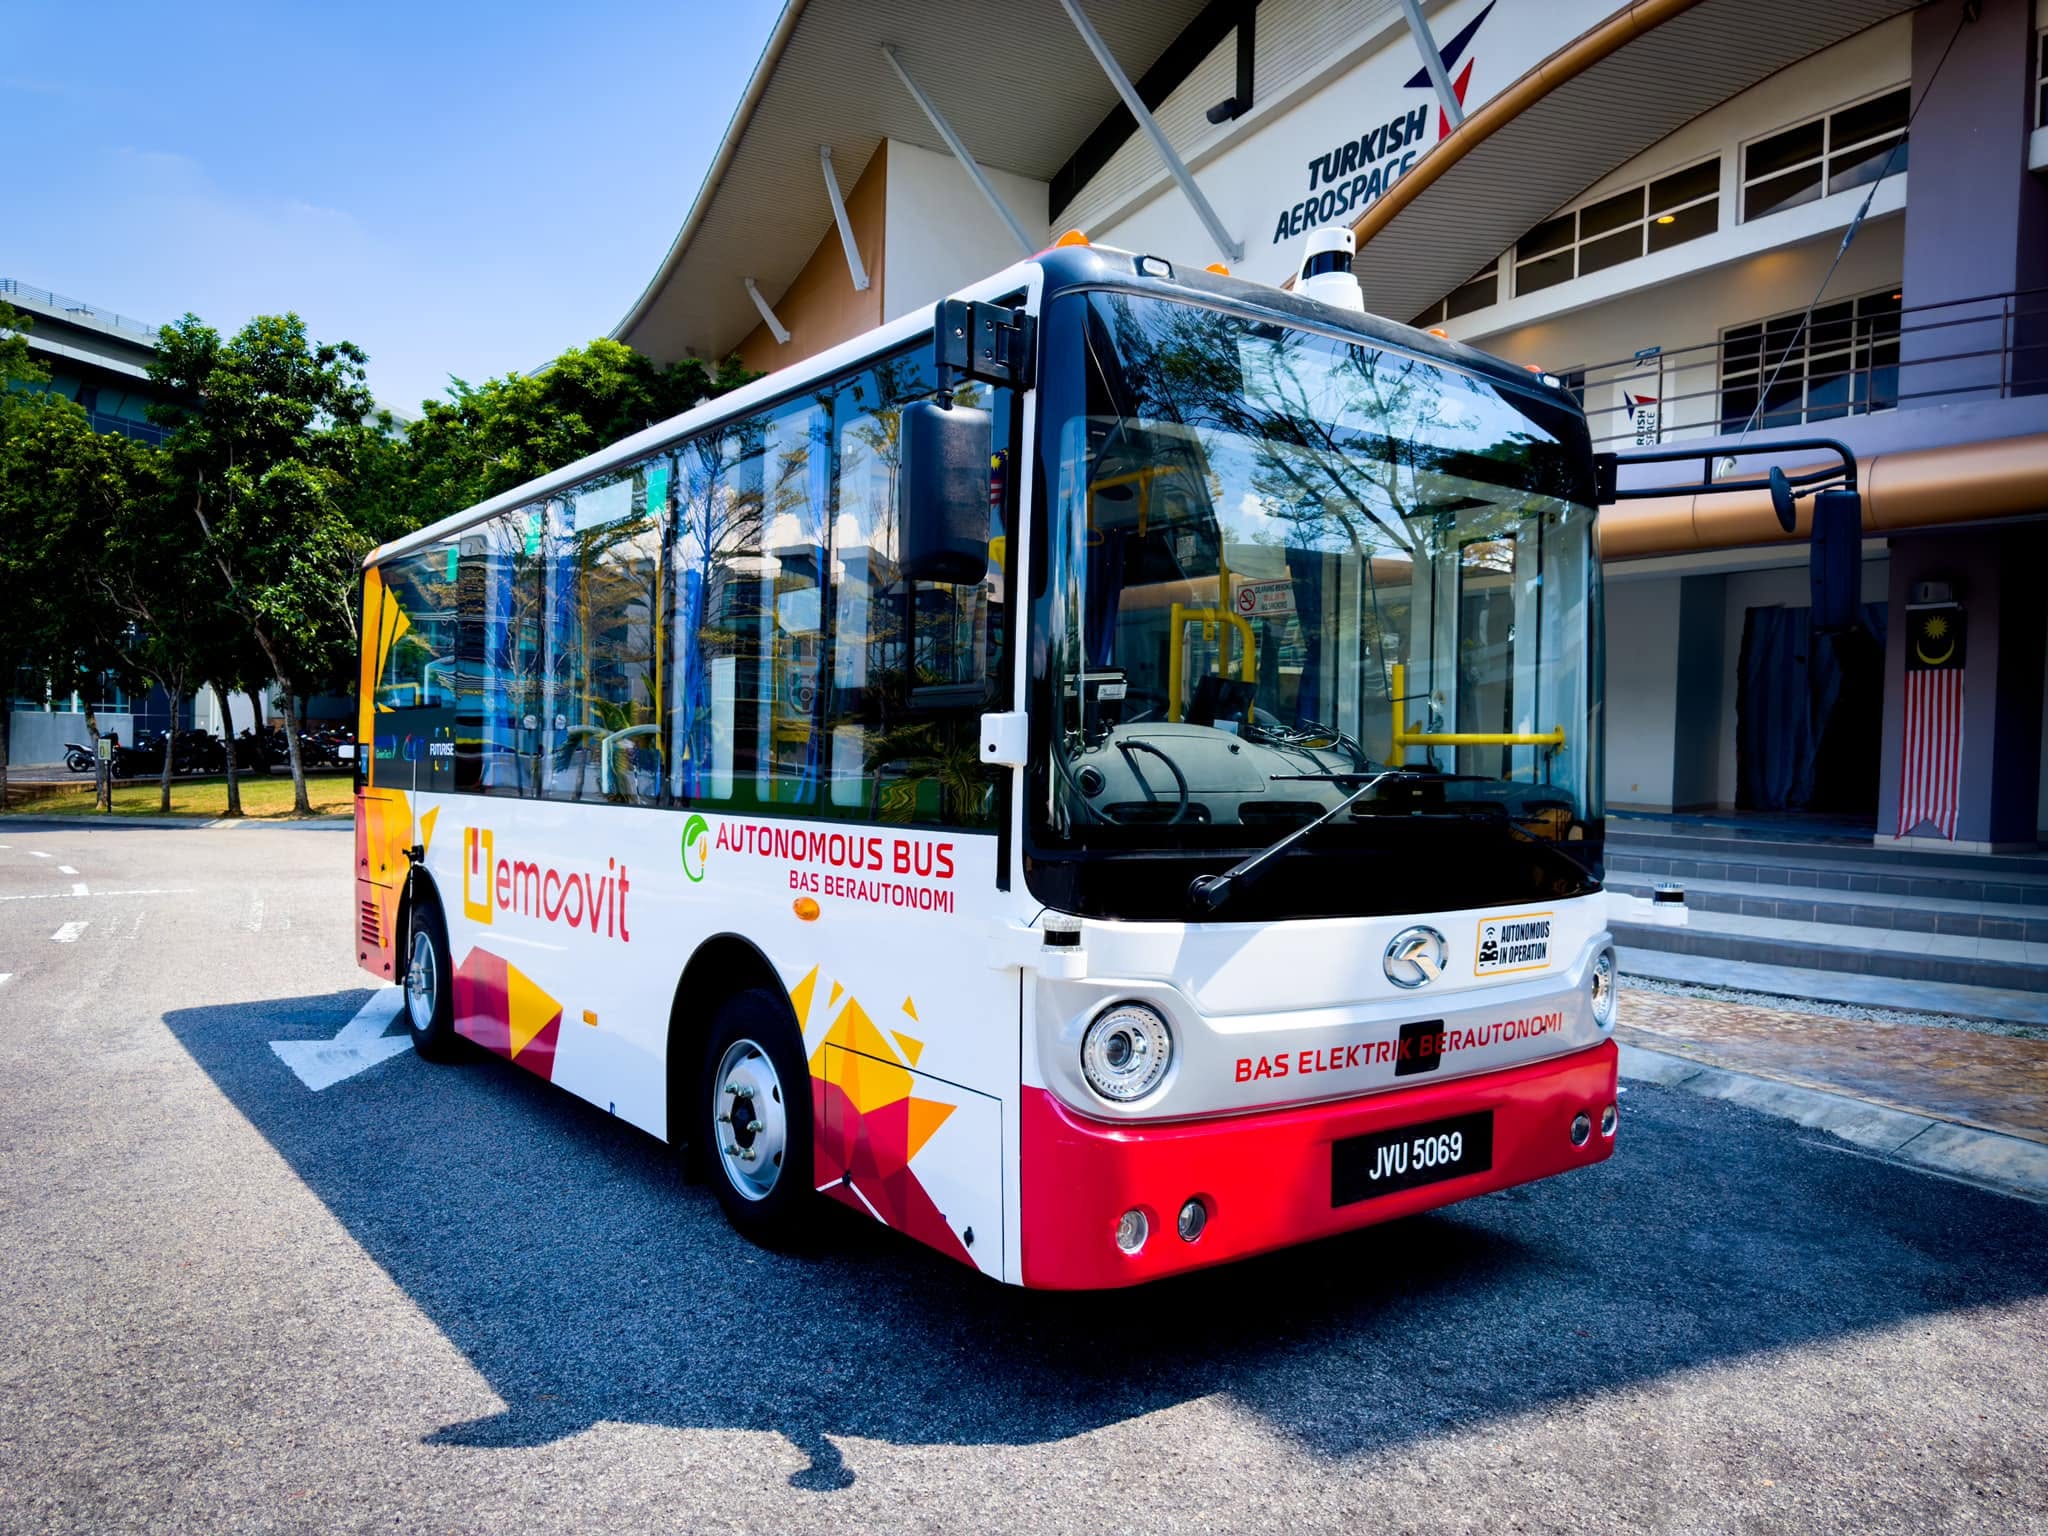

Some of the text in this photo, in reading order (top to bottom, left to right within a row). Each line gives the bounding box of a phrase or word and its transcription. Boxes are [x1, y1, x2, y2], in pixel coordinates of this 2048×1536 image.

[1308, 104, 1428, 191] TURKISH
[1636, 410, 1646, 446] RKISH
[1646, 411, 1655, 446] SPACE
[715, 822, 955, 879] AUTONOMOUS BUS
[789, 870, 954, 914] BAS BERAUTONOMI
[1499, 941, 1547, 965] IN OPERATION
[1500, 920, 1551, 943] AUTONOMOUS
[1234, 1011, 1563, 1083] BAS ELEKTRIK BERAUTONOMI
[1368, 1131, 1463, 1180] JVU 5069
